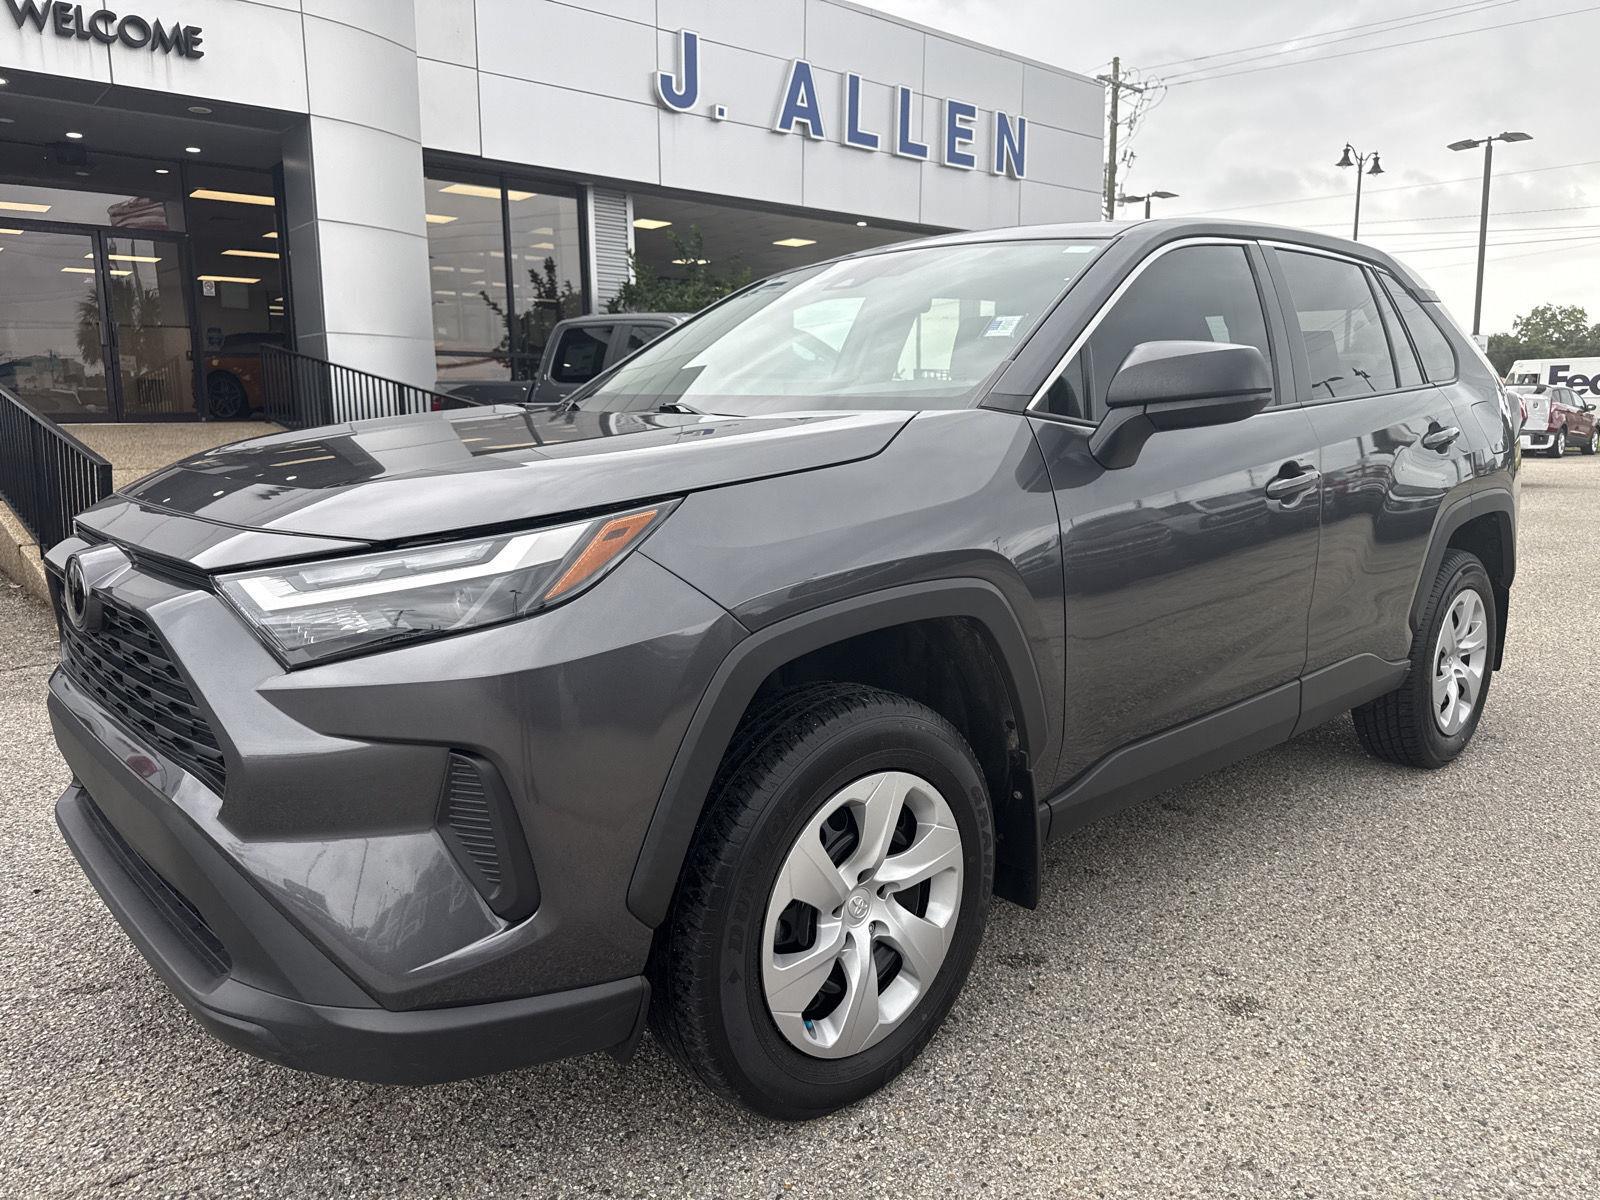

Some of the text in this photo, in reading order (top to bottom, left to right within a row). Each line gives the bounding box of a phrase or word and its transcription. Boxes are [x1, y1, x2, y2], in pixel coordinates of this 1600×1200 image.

[5, 0, 204, 59] WELCOME
[654, 29, 1028, 179] J. ALLEN
